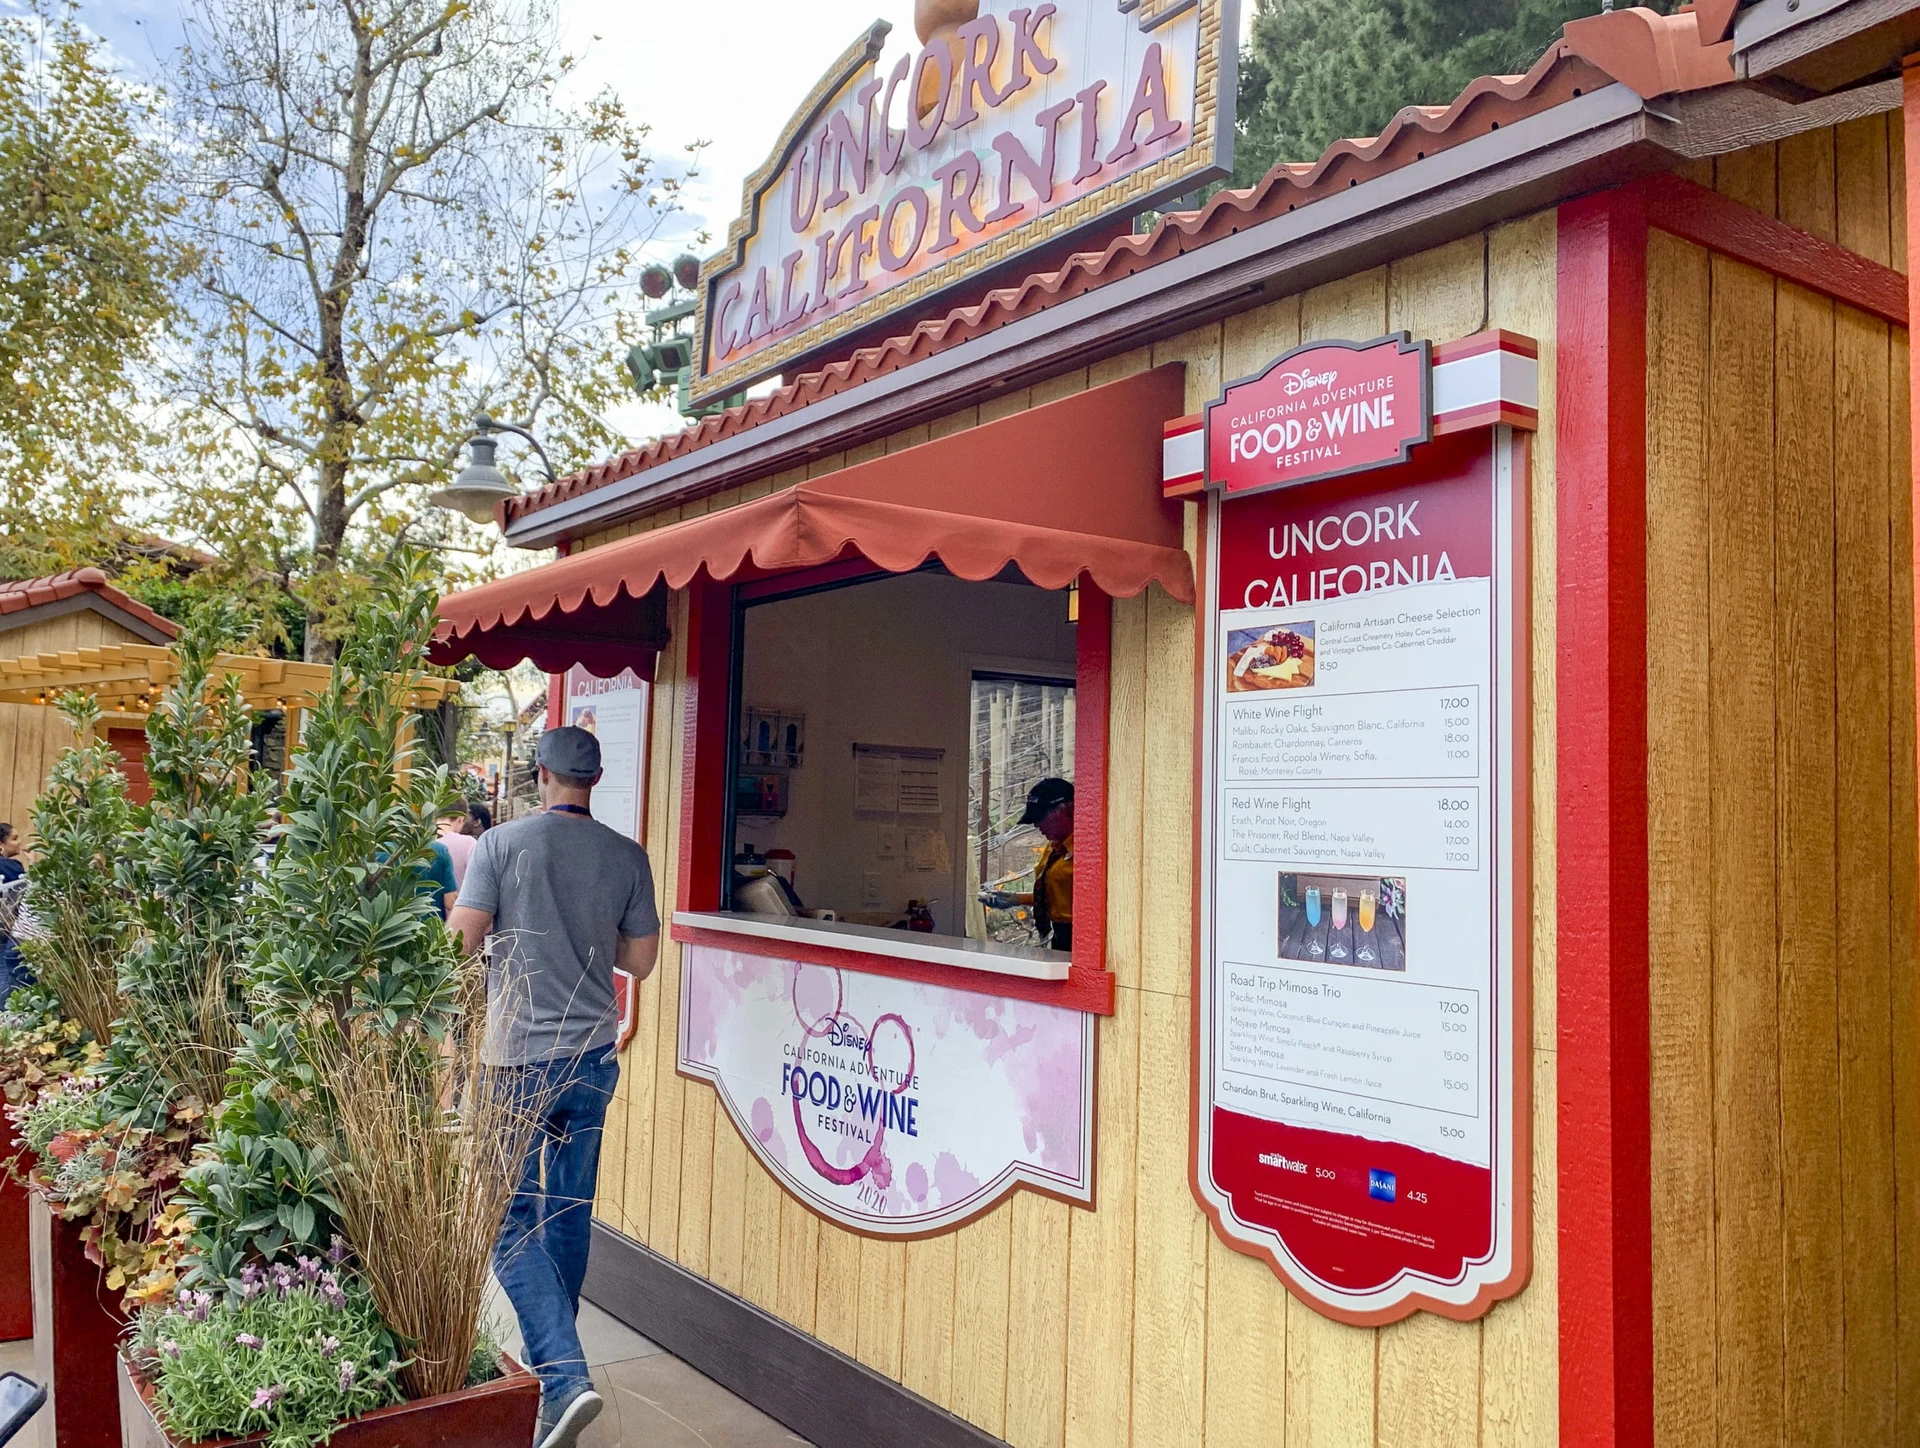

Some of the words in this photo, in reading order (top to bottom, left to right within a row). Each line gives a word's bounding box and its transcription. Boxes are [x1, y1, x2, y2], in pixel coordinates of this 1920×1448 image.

[789, 2, 1058, 233] UNCORK
[714, 42, 1182, 361] CALIFORNIA
[1231, 400, 1307, 429] CALIFORNIA
[1312, 375, 1394, 407] ADVENTURE
[1230, 418, 1302, 463] FOOD
[1305, 418, 1322, 442] &
[1322, 395, 1395, 440] WINE
[1276, 443, 1341, 469] FESTIVAL
[1269, 500, 1421, 560] UNCORK
[1245, 551, 1457, 609] CALIFORNIA
[1320, 620, 1361, 632] California
[1364, 618, 1394, 627] Artisan
[1398, 613, 1433, 623] Cheese
[1436, 608, 1480, 619] Selection
[1320, 637, 1341, 645] Central
[1395, 630, 1413, 638] Holey
[1415, 628, 1431, 636] Cow
[1394, 640, 1425, 648] Cabernet
[1427, 636, 1456, 645] Cheddar
[1320, 661, 1337, 670] 8.50
[578, 675, 633, 697] CALIFORNIA
[1440, 698, 1469, 709] 17.00
[1233, 709, 1261, 719] White
[1265, 707, 1290, 718] Wine
[1293, 704, 1322, 719] Flight
[1233, 726, 1258, 735] Malibu
[1261, 724, 1284, 736] Rocky
[1311, 723, 1354, 734] Sauvignon
[1387, 719, 1425, 729] California
[1444, 718, 1469, 727] 15.00
[1328, 737, 1362, 746] Carneros
[1444, 733, 1469, 743] 18.00
[1232, 754, 1259, 763] Francis
[1261, 753, 1279, 763] Ford
[1282, 752, 1317, 764] Coppola
[1447, 750, 1469, 759] 11.00
[1261, 767, 1294, 776] Monterey
[1296, 766, 1322, 775] County
[1232, 797, 1250, 809] Red
[1254, 798, 1279, 809] Wine
[1282, 797, 1310, 812] Flight
[1438, 799, 1469, 811] 18.00
[1256, 815, 1275, 825] Pinot
[1298, 817, 1327, 828] Oregon
[1443, 820, 1469, 829] 14.00
[1232, 829, 1245, 838] The
[1283, 831, 1299, 840] Red
[1331, 833, 1350, 843] Napa
[1352, 833, 1375, 844] Valley
[1446, 837, 1469, 845] 17.00
[1253, 844, 1291, 854] Cabernet
[1341, 848, 1360, 858] Napa
[1363, 849, 1385, 859] Valley
[1446, 853, 1469, 861] 17.00
[1231, 973, 1254, 987] Road
[1258, 976, 1276, 992] Trip
[1279, 979, 1318, 995] Mimosa
[1322, 984, 1341, 998] Trio
[1230, 991, 1254, 1003] Pacific
[1257, 995, 1287, 1008] Mimosa
[1439, 1002, 1469, 1014] 17.00
[1230, 1016, 1257, 1030] Mojave
[1260, 1021, 1290, 1034] Mimosa
[1306, 1015, 1320, 1024] Blue
[1366, 1023, 1400, 1035] Pineapple
[1402, 1029, 1421, 1038] Juice
[1441, 1022, 1467, 1032] 15.00
[1230, 1041, 1251, 1053] Sierra
[1254, 1045, 1284, 1059] Mimosa
[1372, 1052, 1392, 1062] Syrup
[1443, 1052, 1469, 1061] 15.00
[784, 1043, 846, 1071] CALIFORNIA
[850, 1060, 919, 1090] ADVENTURE
[1320, 1070, 1338, 1079] Fresh
[1340, 1073, 1362, 1084] Lemon
[1365, 1078, 1382, 1088] Juice
[1443, 1080, 1468, 1090] 15.00
[782, 1063, 841, 1111] FOOD
[844, 1085, 857, 1113] &
[858, 1083, 918, 1137] WINE
[1223, 1081, 1257, 1097] Chandon
[1260, 1088, 1278, 1102] Brut,
[1281, 1093, 1318, 1112] Sparkling
[1321, 1101, 1345, 1116] Wine,
[1348, 1106, 1391, 1124] California
[818, 1115, 872, 1143] FESTIVAL
[1440, 1127, 1465, 1138] 15.00
[1259, 1153, 1307, 1174] smartwater
[1316, 1168, 1336, 1180] 5.00
[1371, 1179, 1394, 1191] DASANI
[857, 1181, 888, 1215] 2020
[1407, 1191, 1427, 1203] 4.25
